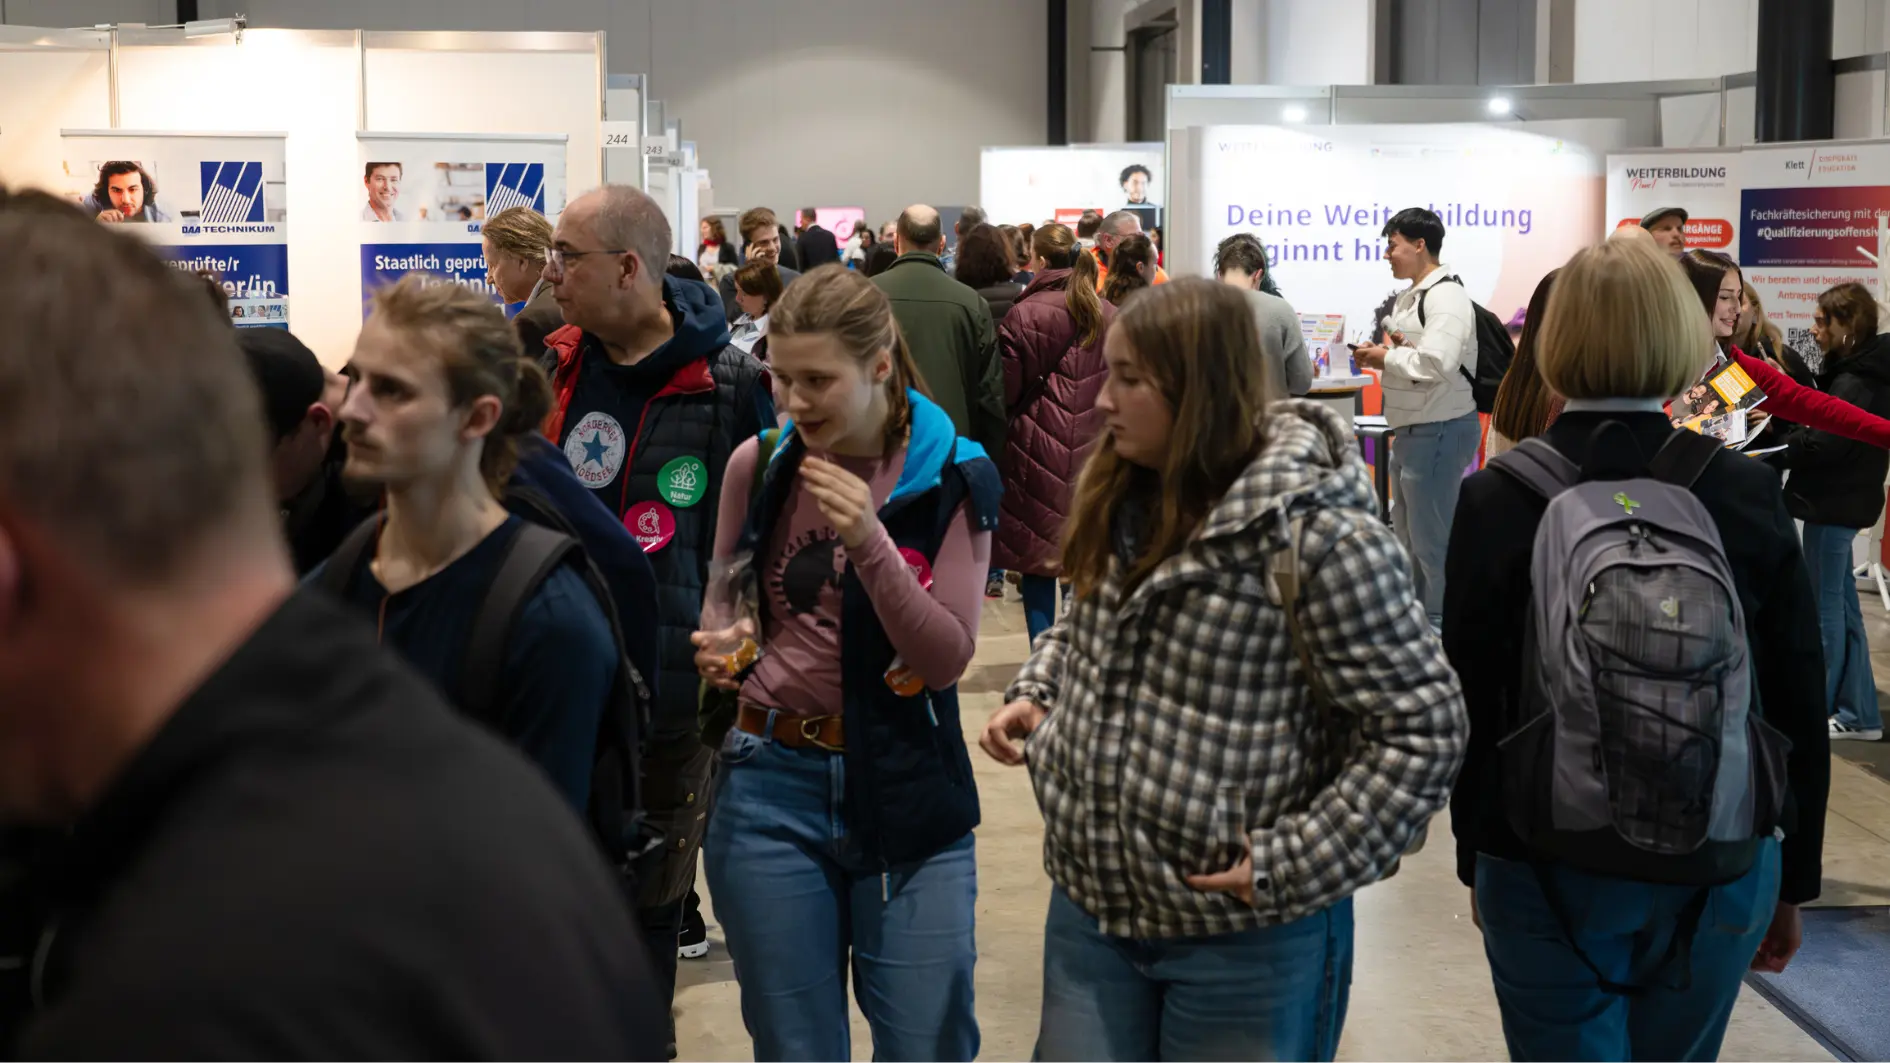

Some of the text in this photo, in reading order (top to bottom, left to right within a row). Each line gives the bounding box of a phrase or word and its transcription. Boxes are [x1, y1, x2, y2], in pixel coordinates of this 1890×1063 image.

[605, 134, 629, 145] 244
[644, 146, 663, 155] 243
[1785, 160, 1805, 170] Klett
[1626, 167, 1727, 178] WEITERBILDUNG
[1227, 203, 1312, 226] Deine
[1750, 208, 1851, 222] Fachkräftesicherung
[1853, 207, 1871, 219] mit
[1757, 225, 1879, 240] #Qualifizierungsoffensiv
[1265, 238, 1343, 268] ginnt
[374, 254, 488, 273] Staatlich geprü
[1751, 275, 1765, 284] Wir
[1768, 275, 1801, 284] beraten
[1803, 275, 1820, 284] und
[1867, 275, 1878, 285] im
[1777, 290, 1818, 302] Antragsp
[1785, 310, 1810, 319] Termin
[670, 490, 692, 501] Natur
